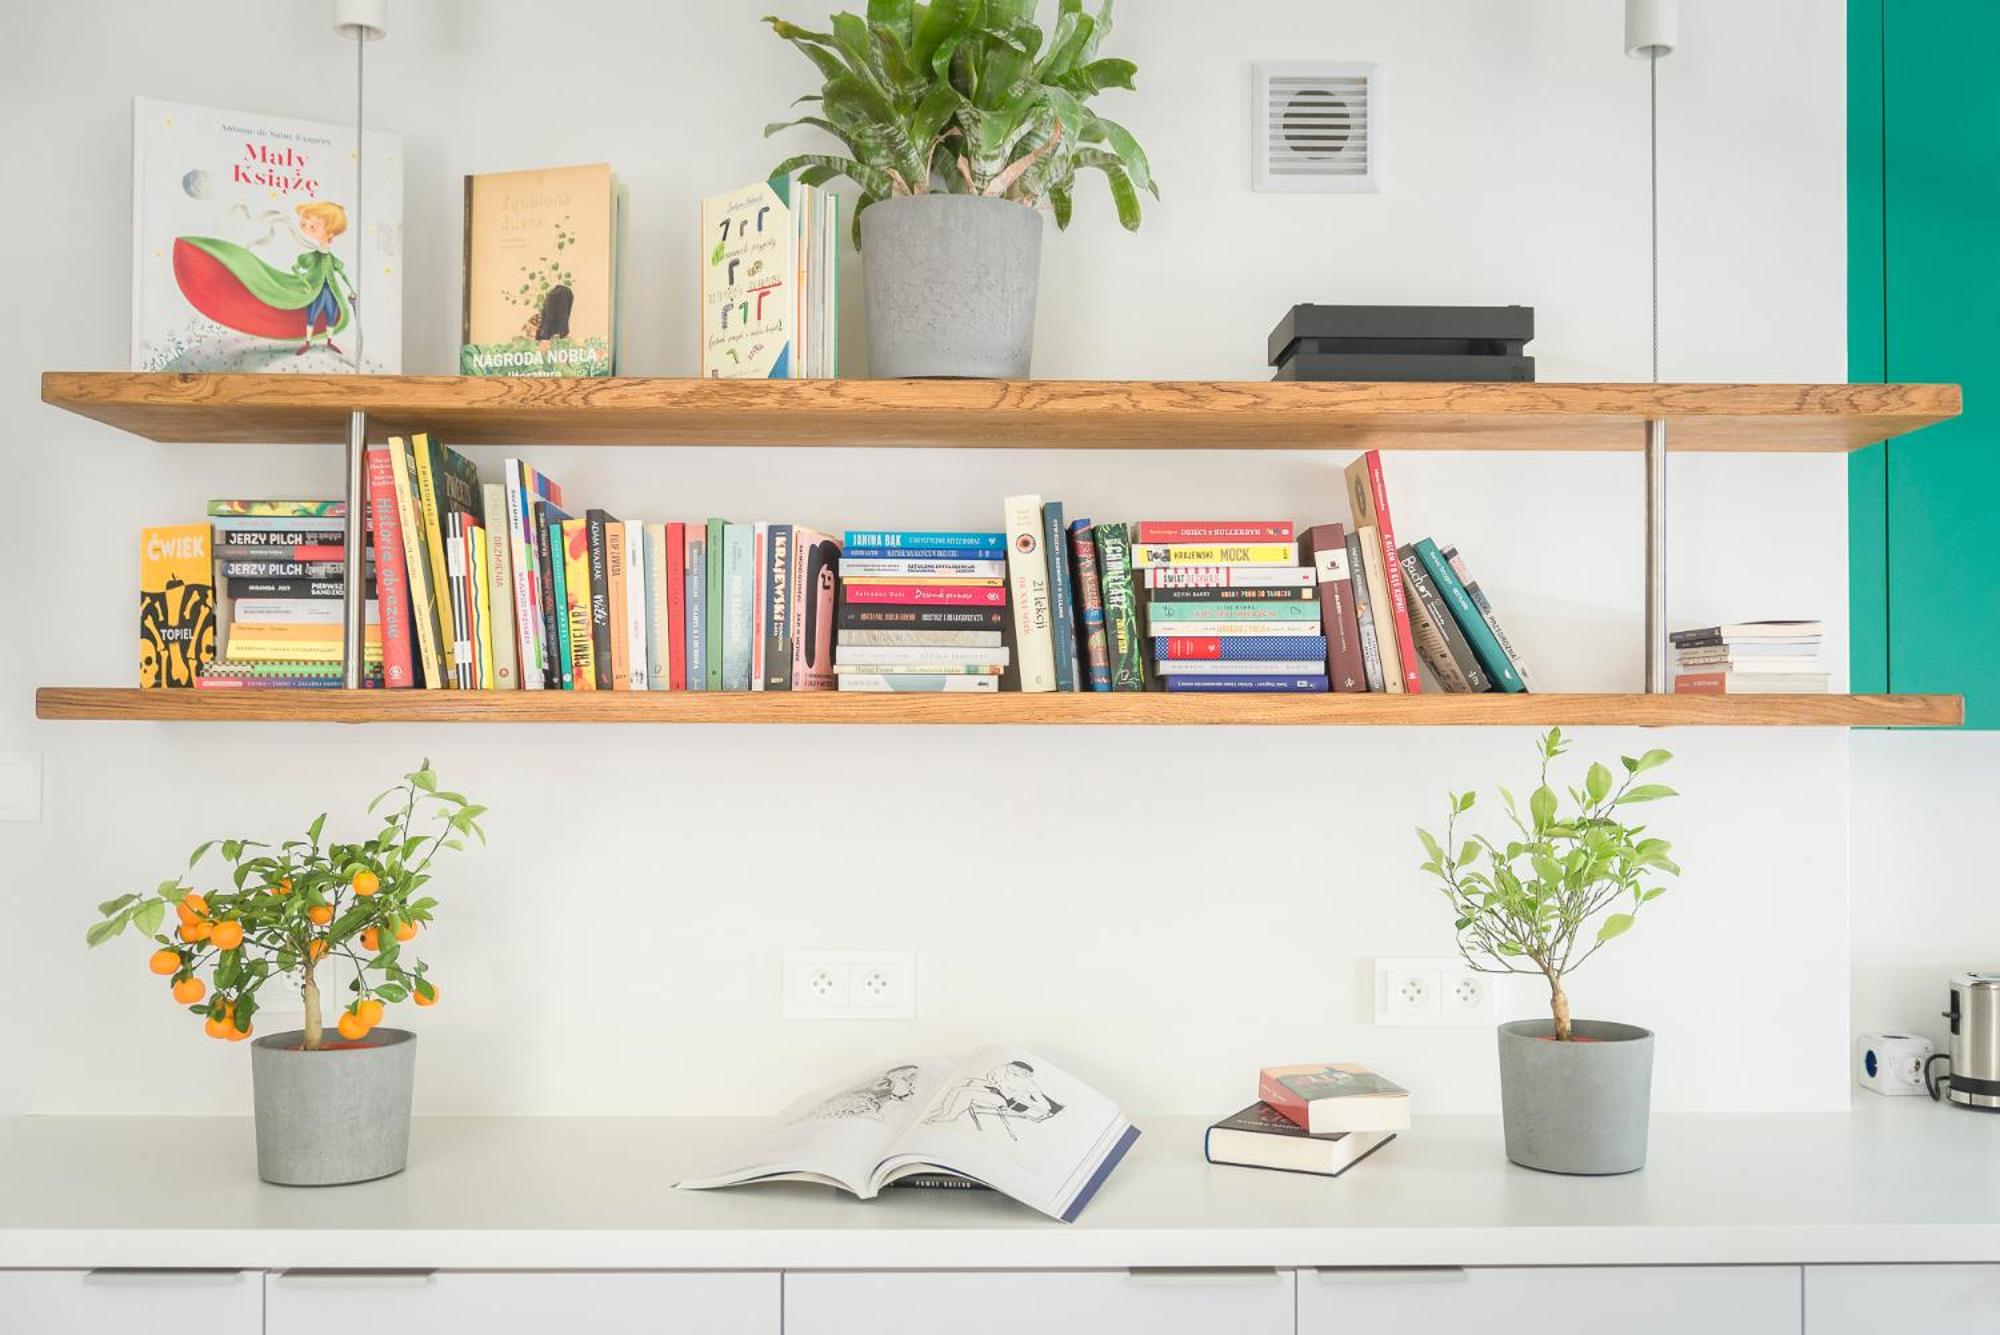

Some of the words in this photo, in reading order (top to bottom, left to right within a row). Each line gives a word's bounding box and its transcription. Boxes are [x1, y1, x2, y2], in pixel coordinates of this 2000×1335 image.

[244, 143, 309, 171] Mały
[233, 164, 319, 198] Książę
[473, 349, 544, 369] NAGRODA
[547, 347, 598, 365] NOBLA
[229, 533, 266, 546] JERZY
[269, 533, 303, 546] PILCH
[376, 497, 394, 561] Historia
[147, 534, 205, 561] ĆWIEK
[852, 533, 882, 546] JANINA
[885, 534, 902, 548] BĄK
[593, 547, 602, 580] WAJRAK
[1174, 550, 1213, 560] KRAJEWSKI
[1220, 548, 1250, 561] MOCK
[228, 563, 266, 576] JERZY
[269, 563, 302, 575] PILCH
[772, 536, 787, 624] KRAJEWSKI
[311, 582, 344, 590] PIERWSZ
[1032, 580, 1044, 594] 21
[1034, 596, 1049, 630] lekcji
[160, 628, 194, 641] TOPIEL
